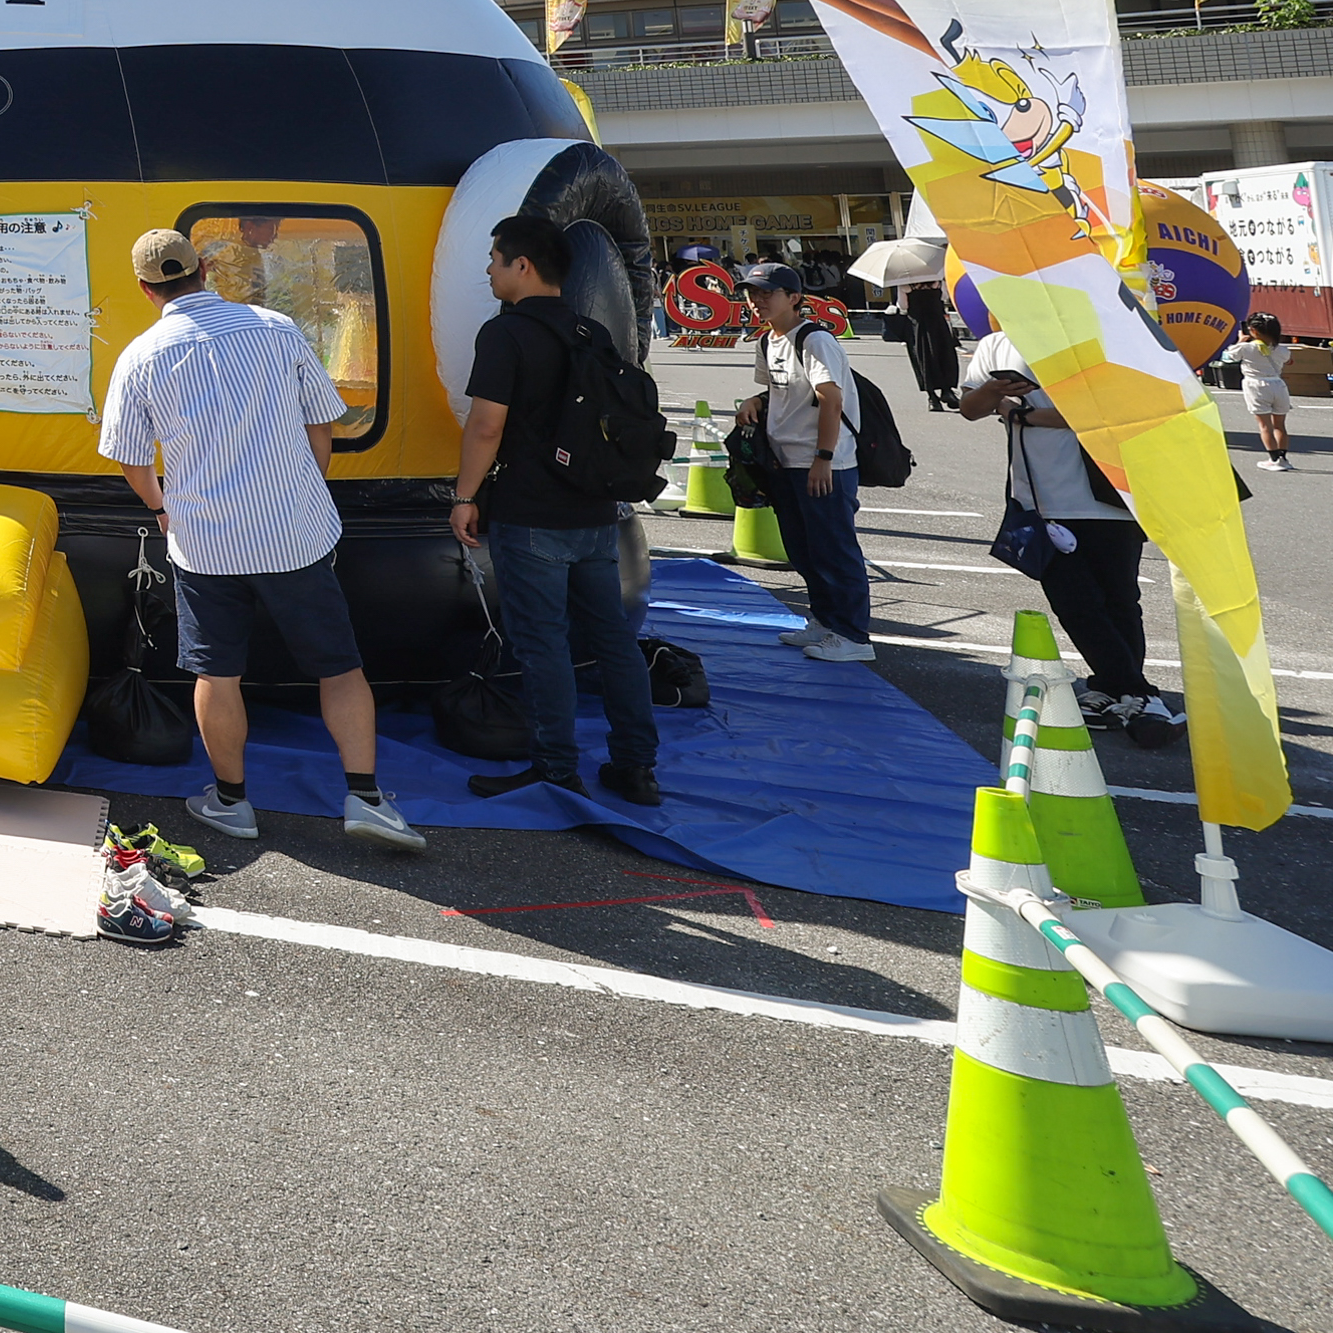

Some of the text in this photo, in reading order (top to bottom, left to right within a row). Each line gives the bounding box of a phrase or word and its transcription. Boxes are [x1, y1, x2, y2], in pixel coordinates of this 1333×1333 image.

[643, 202, 741, 213] 同生命SV.LEAGUE
[749, 215, 813, 231] GAME
[1157, 223, 1219, 256] AICHI
[1166, 312, 1202, 324] HOME
[1203, 315, 1228, 333] GAME
[669, 335, 741, 349] AICHI
[1079, 899, 1102, 908] TAIYO
